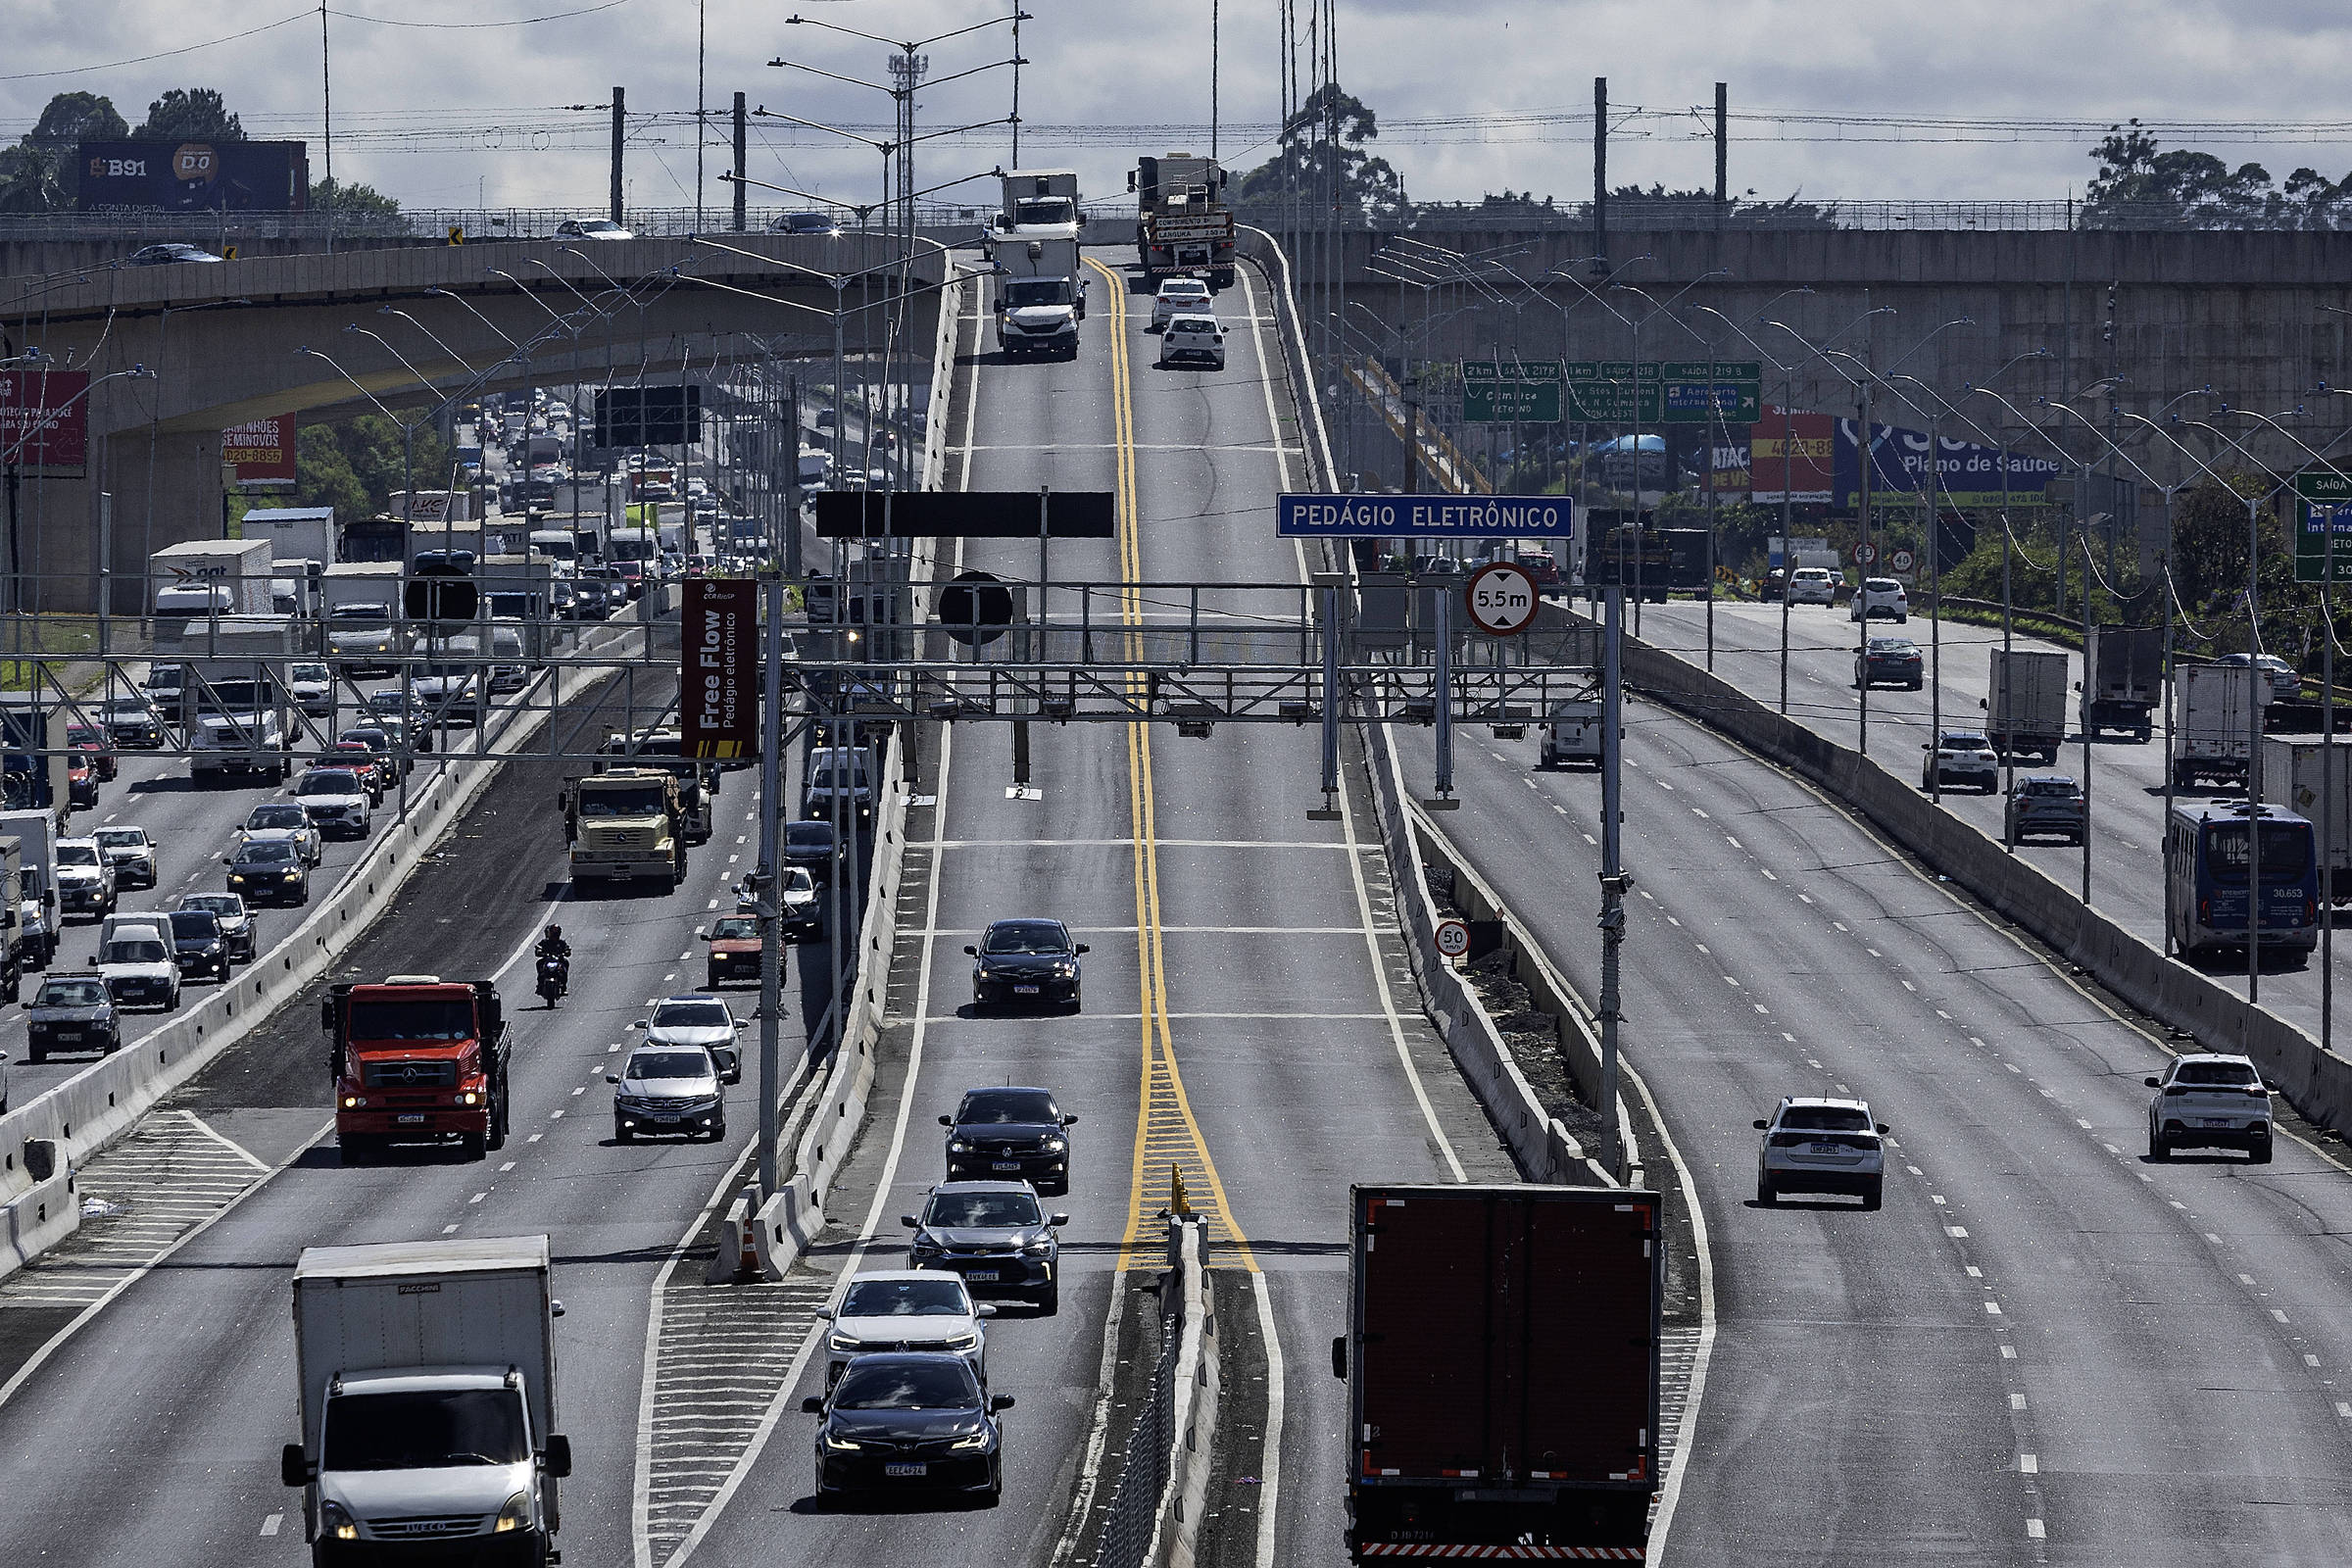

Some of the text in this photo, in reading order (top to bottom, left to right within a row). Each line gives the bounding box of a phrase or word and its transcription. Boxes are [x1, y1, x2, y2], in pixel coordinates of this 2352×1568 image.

[108, 159, 147, 176] B91
[1904, 456, 1958, 472] Plano
[1964, 455, 1992, 471] de
[2316, 477, 2348, 491] SAÍDA
[1293, 498, 1558, 528] PEDÁGIO ELETRÔNICO
[699, 610, 720, 729] Free Flow
[723, 612, 738, 728] Pedágio eletrônico
[1444, 931, 1463, 944] 50
[406, 1521, 447, 1534] IVECO
